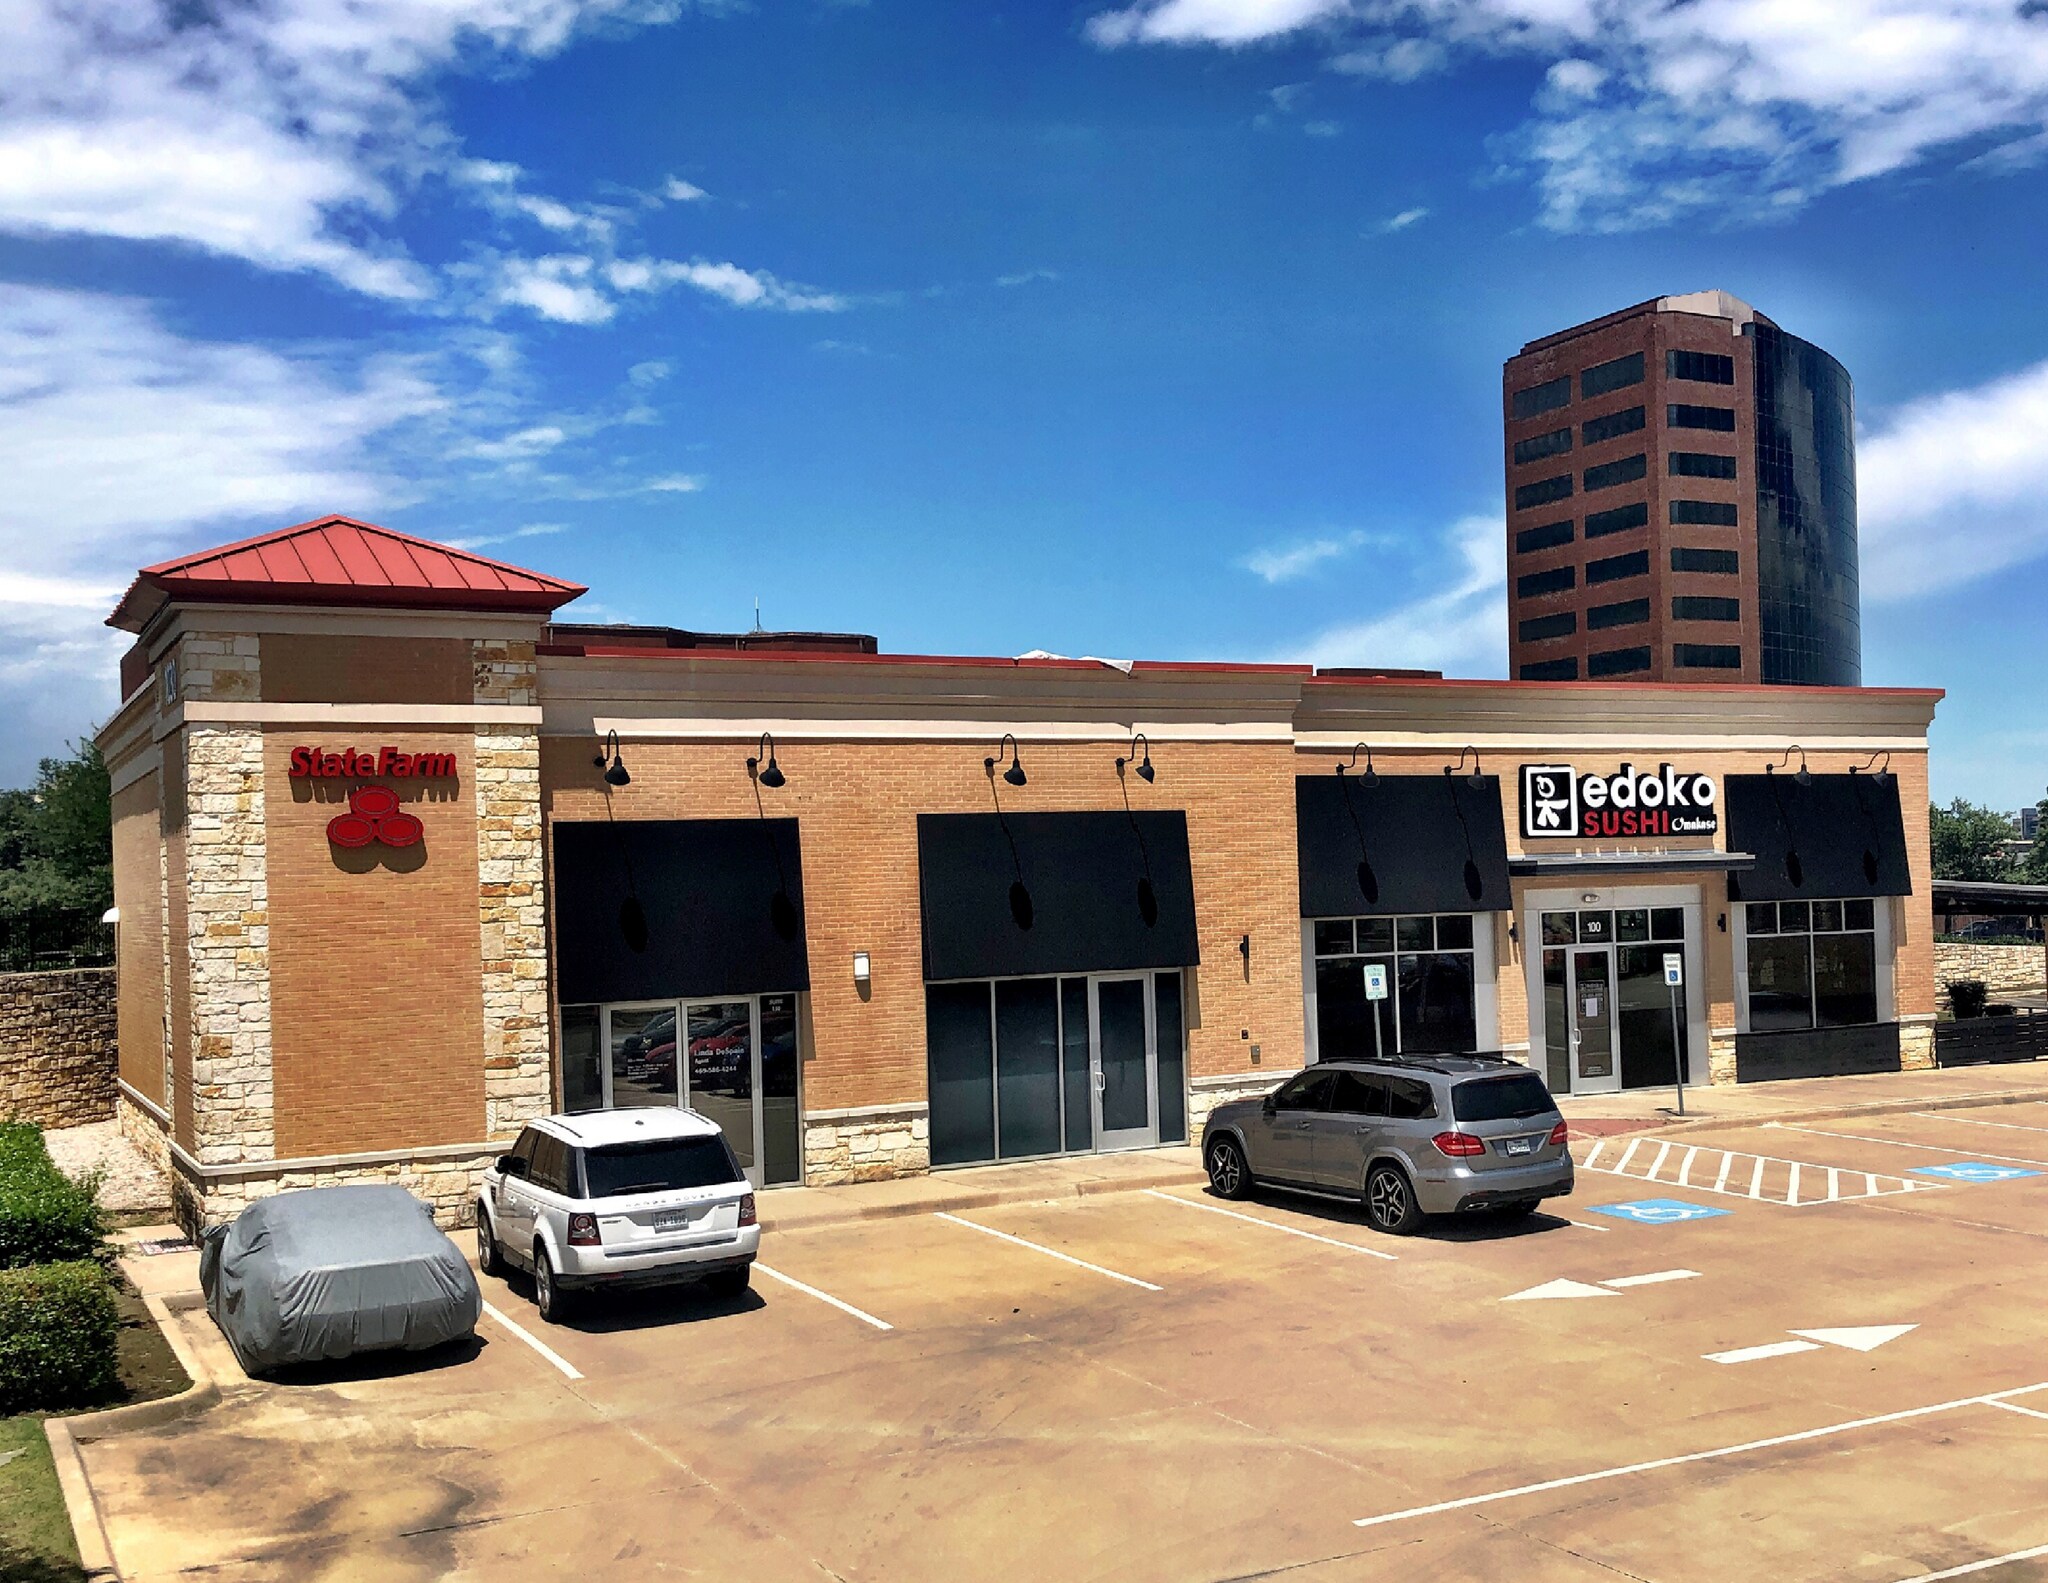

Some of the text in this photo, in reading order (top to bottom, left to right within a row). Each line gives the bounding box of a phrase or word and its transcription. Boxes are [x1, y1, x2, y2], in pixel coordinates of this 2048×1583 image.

[288, 746, 458, 778] State Farm
[1582, 765, 1717, 808] edoko
[1583, 810, 1717, 836] SUSHI Omakase
[1587, 921, 1602, 933] 100
[694, 1049, 714, 1057] Linda
